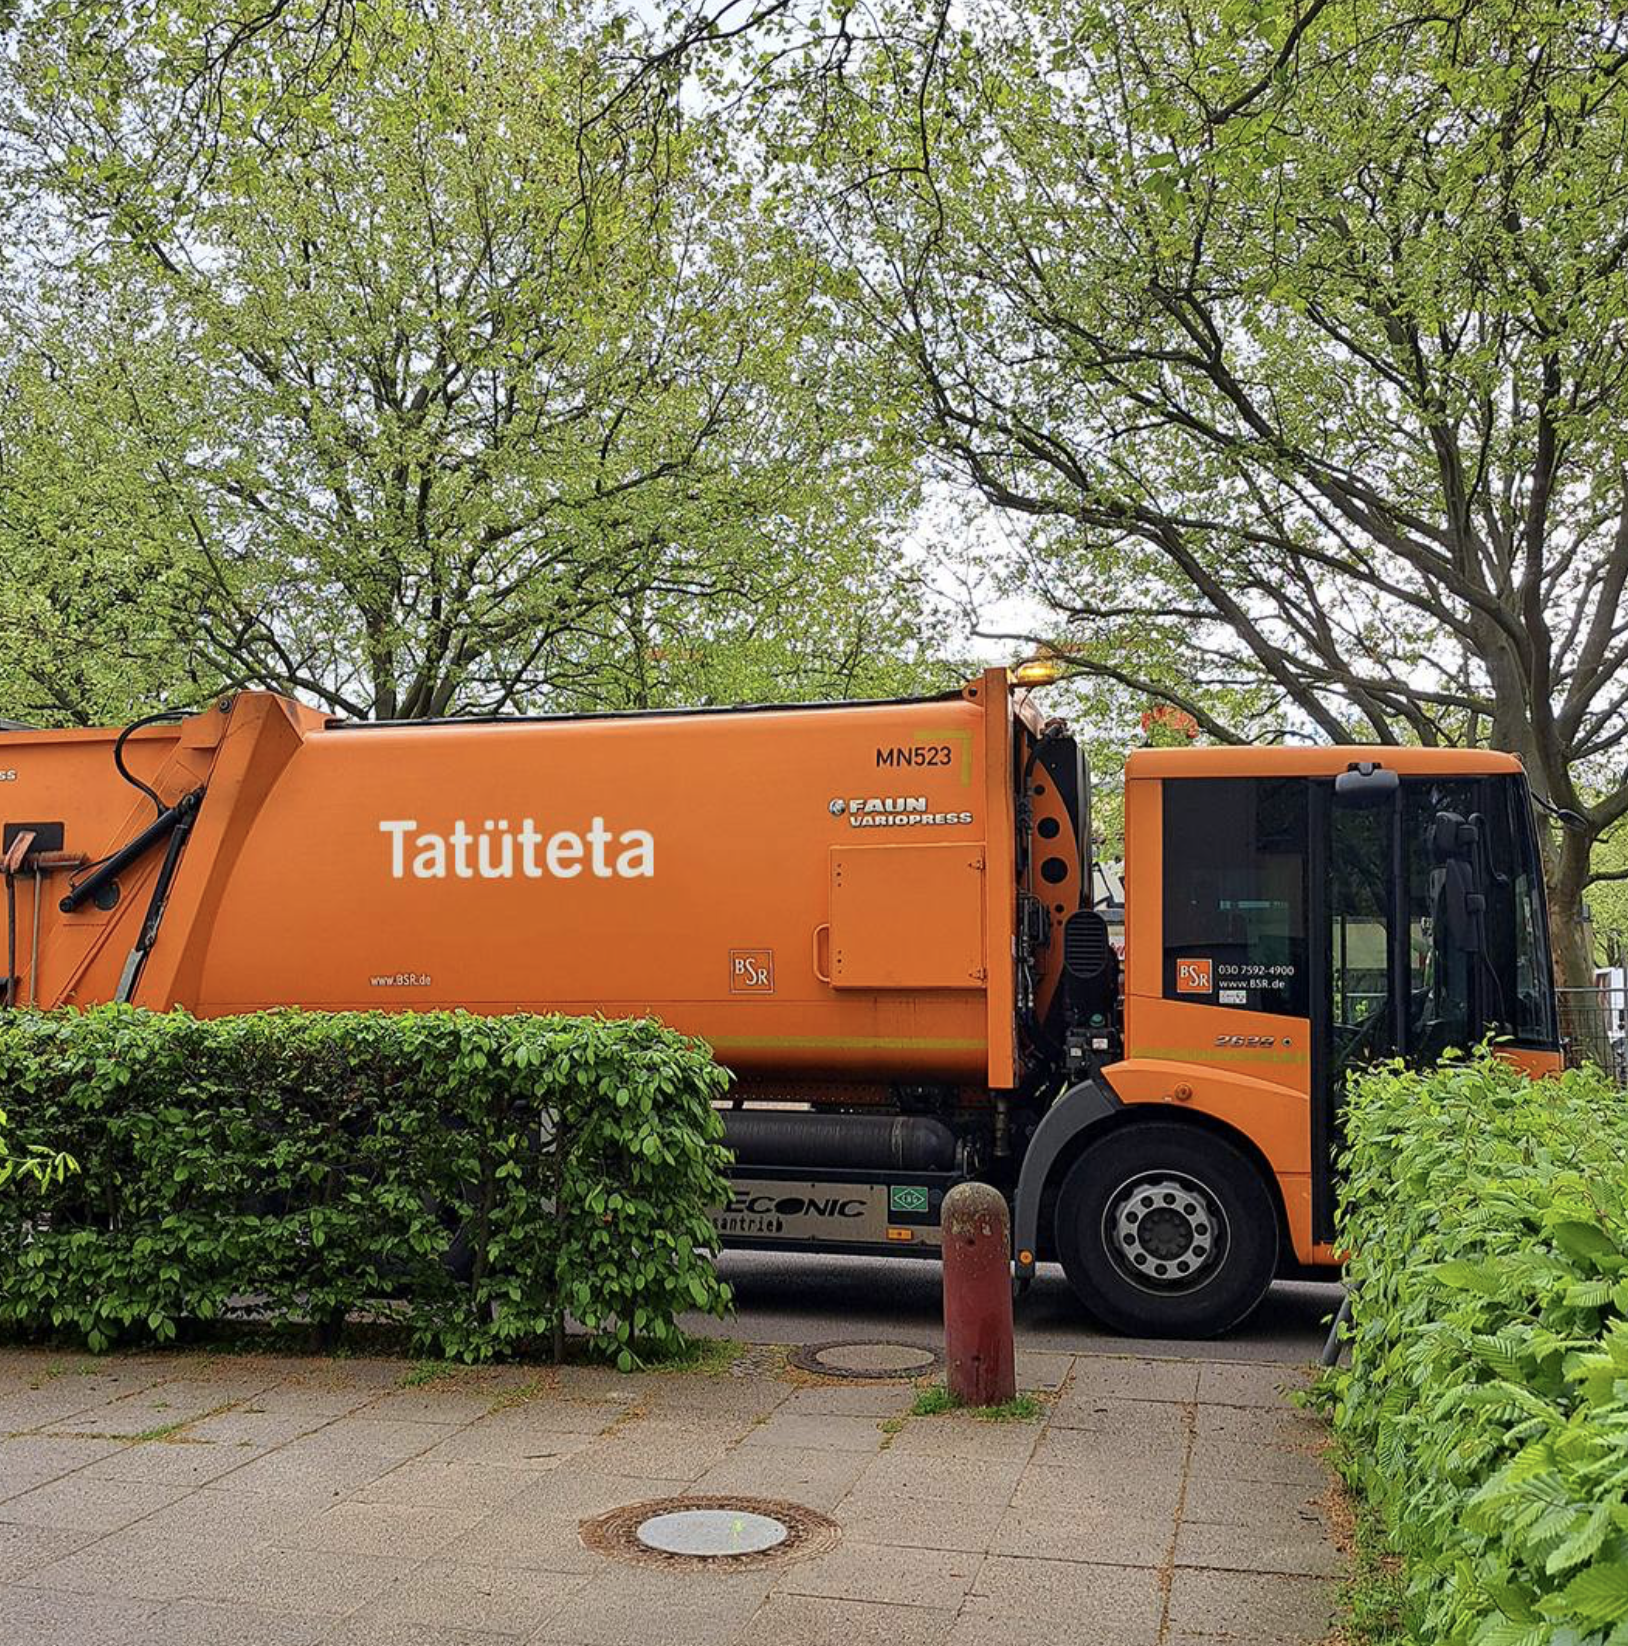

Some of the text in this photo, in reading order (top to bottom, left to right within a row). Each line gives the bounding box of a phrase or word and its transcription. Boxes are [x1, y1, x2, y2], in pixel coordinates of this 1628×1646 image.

[876, 746, 952, 767] MN523
[849, 797, 927, 813] FAUN
[850, 812, 973, 827] VARIOPRESS
[379, 816, 655, 878] Tatüteta
[734, 957, 769, 986] BSR
[1180, 965, 1209, 987] BSR
[1218, 965, 1295, 975] 030 7592-4900
[370, 973, 431, 986] www.BSR.de
[1219, 980, 1286, 989] www.BSR.de
